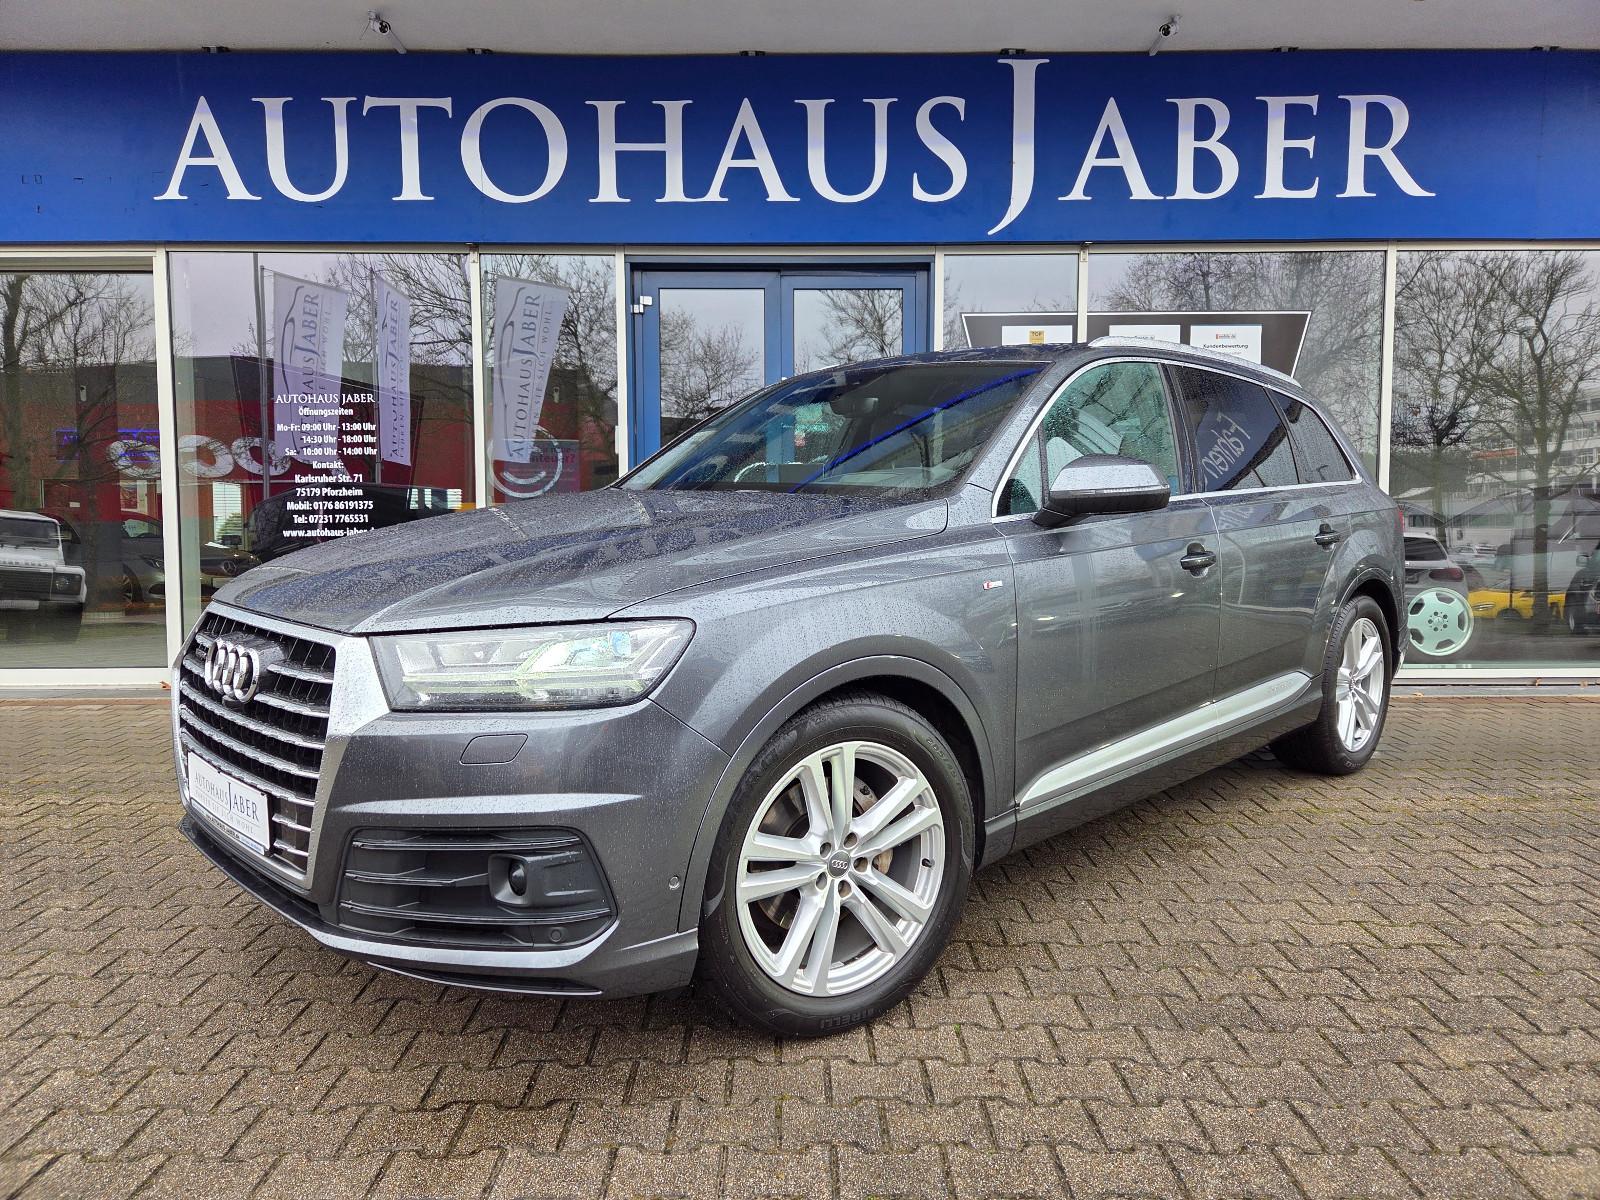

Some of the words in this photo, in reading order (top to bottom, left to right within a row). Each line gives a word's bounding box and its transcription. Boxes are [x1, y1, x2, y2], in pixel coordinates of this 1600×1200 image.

[153, 96, 968, 204] AUTOHAUS
[987, 58, 1436, 236] JABER
[294, 293, 320, 357] JABER
[512, 294, 541, 359] JABER
[274, 393, 339, 404] AUTOHAUS
[341, 393, 376, 405] JABER
[298, 406, 354, 417] Öffnungszeiten
[511, 359, 533, 457] AUTOHAUS
[276, 423, 301, 431] Mo-Fr:
[301, 423, 322, 431] 09:00
[322, 422, 337, 431] Uhr
[341, 422, 362, 431] 13:00
[362, 422, 377, 431] Uhr
[302, 435, 322, 443] 14:30
[323, 435, 337, 443] Uhr
[342, 434, 363, 443] 18:00
[363, 434, 377, 443] Uhr
[285, 448, 297, 456] Sa:
[302, 447, 323, 455] 10:00
[323, 447, 337, 455] Uhr
[342, 447, 363, 455] 14:00
[363, 447, 377, 455] Uhr
[312, 460, 344, 469] Kontakt:
[294, 474, 337, 483] Karlsruher
[337, 473, 352, 482] Str.
[353, 473, 363, 482] 71
[295, 487, 321, 497] 75179
[321, 486, 364, 496] Pforzheim
[286, 501, 312, 511] Mobil:
[313, 501, 334, 510] 0176
[334, 501, 374, 510] 86191375
[292, 514, 308, 524] Tel:
[308, 514, 333, 523] 07231
[335, 514, 369, 523] 7765531
[226, 782, 260, 822] JABER
